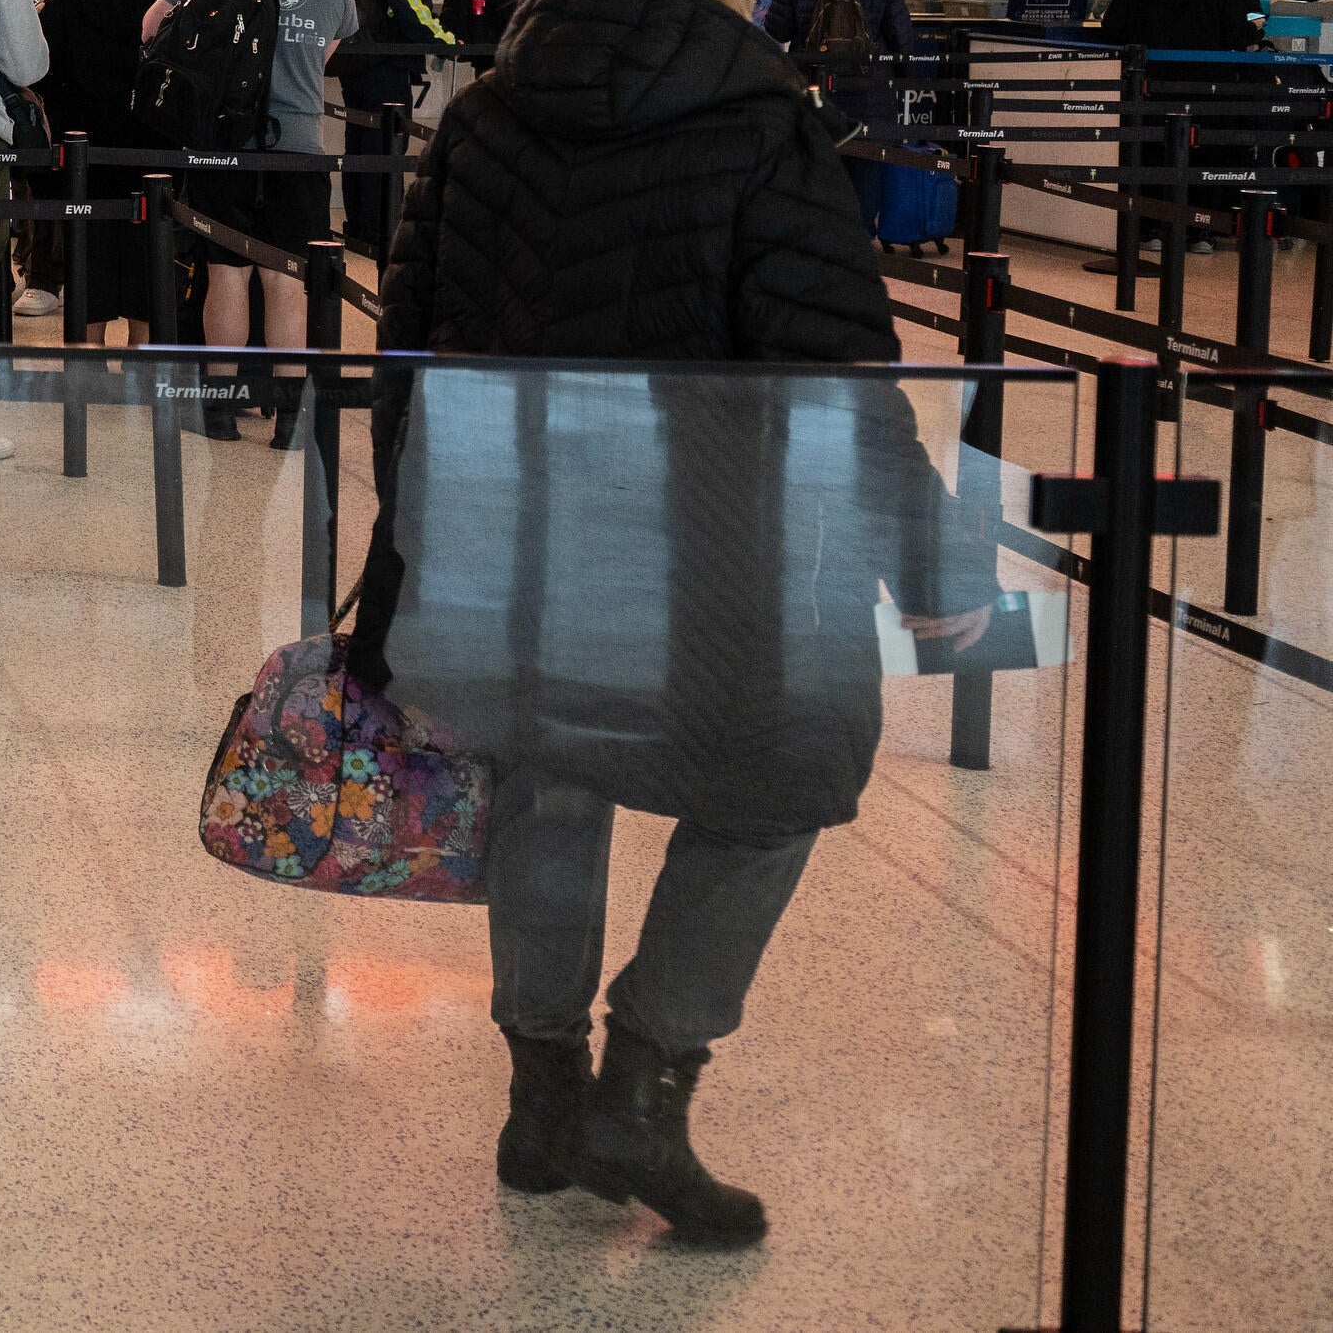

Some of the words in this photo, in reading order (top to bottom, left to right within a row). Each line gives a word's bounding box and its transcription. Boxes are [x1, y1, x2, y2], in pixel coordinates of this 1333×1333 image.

[278, 13, 315, 29] uba
[285, 28, 326, 47] Lucia
[958, 129, 996, 137] Terminal
[188, 155, 229, 165] Terminal
[230, 157, 238, 166] A
[937, 160, 950, 169] EWR
[1202, 172, 1247, 181] Terminal
[1247, 172, 1256, 181] A
[1043, 179, 1066, 193] Terminal
[1066, 185, 1072, 194] A
[65, 205, 92, 215] EWR
[193, 217, 208, 233] Terminal
[1195, 213, 1211, 224] EWR
[287, 260, 298, 272] EWR
[362, 294, 379, 314] Terminal
[1167, 336, 1211, 362] Terminal
[1211, 349, 1219, 363] A
[155, 383, 235, 399] Terminal
[236, 385, 250, 399] A
[1175, 608, 1222, 637] Terminal
[1222, 627, 1229, 641] A
